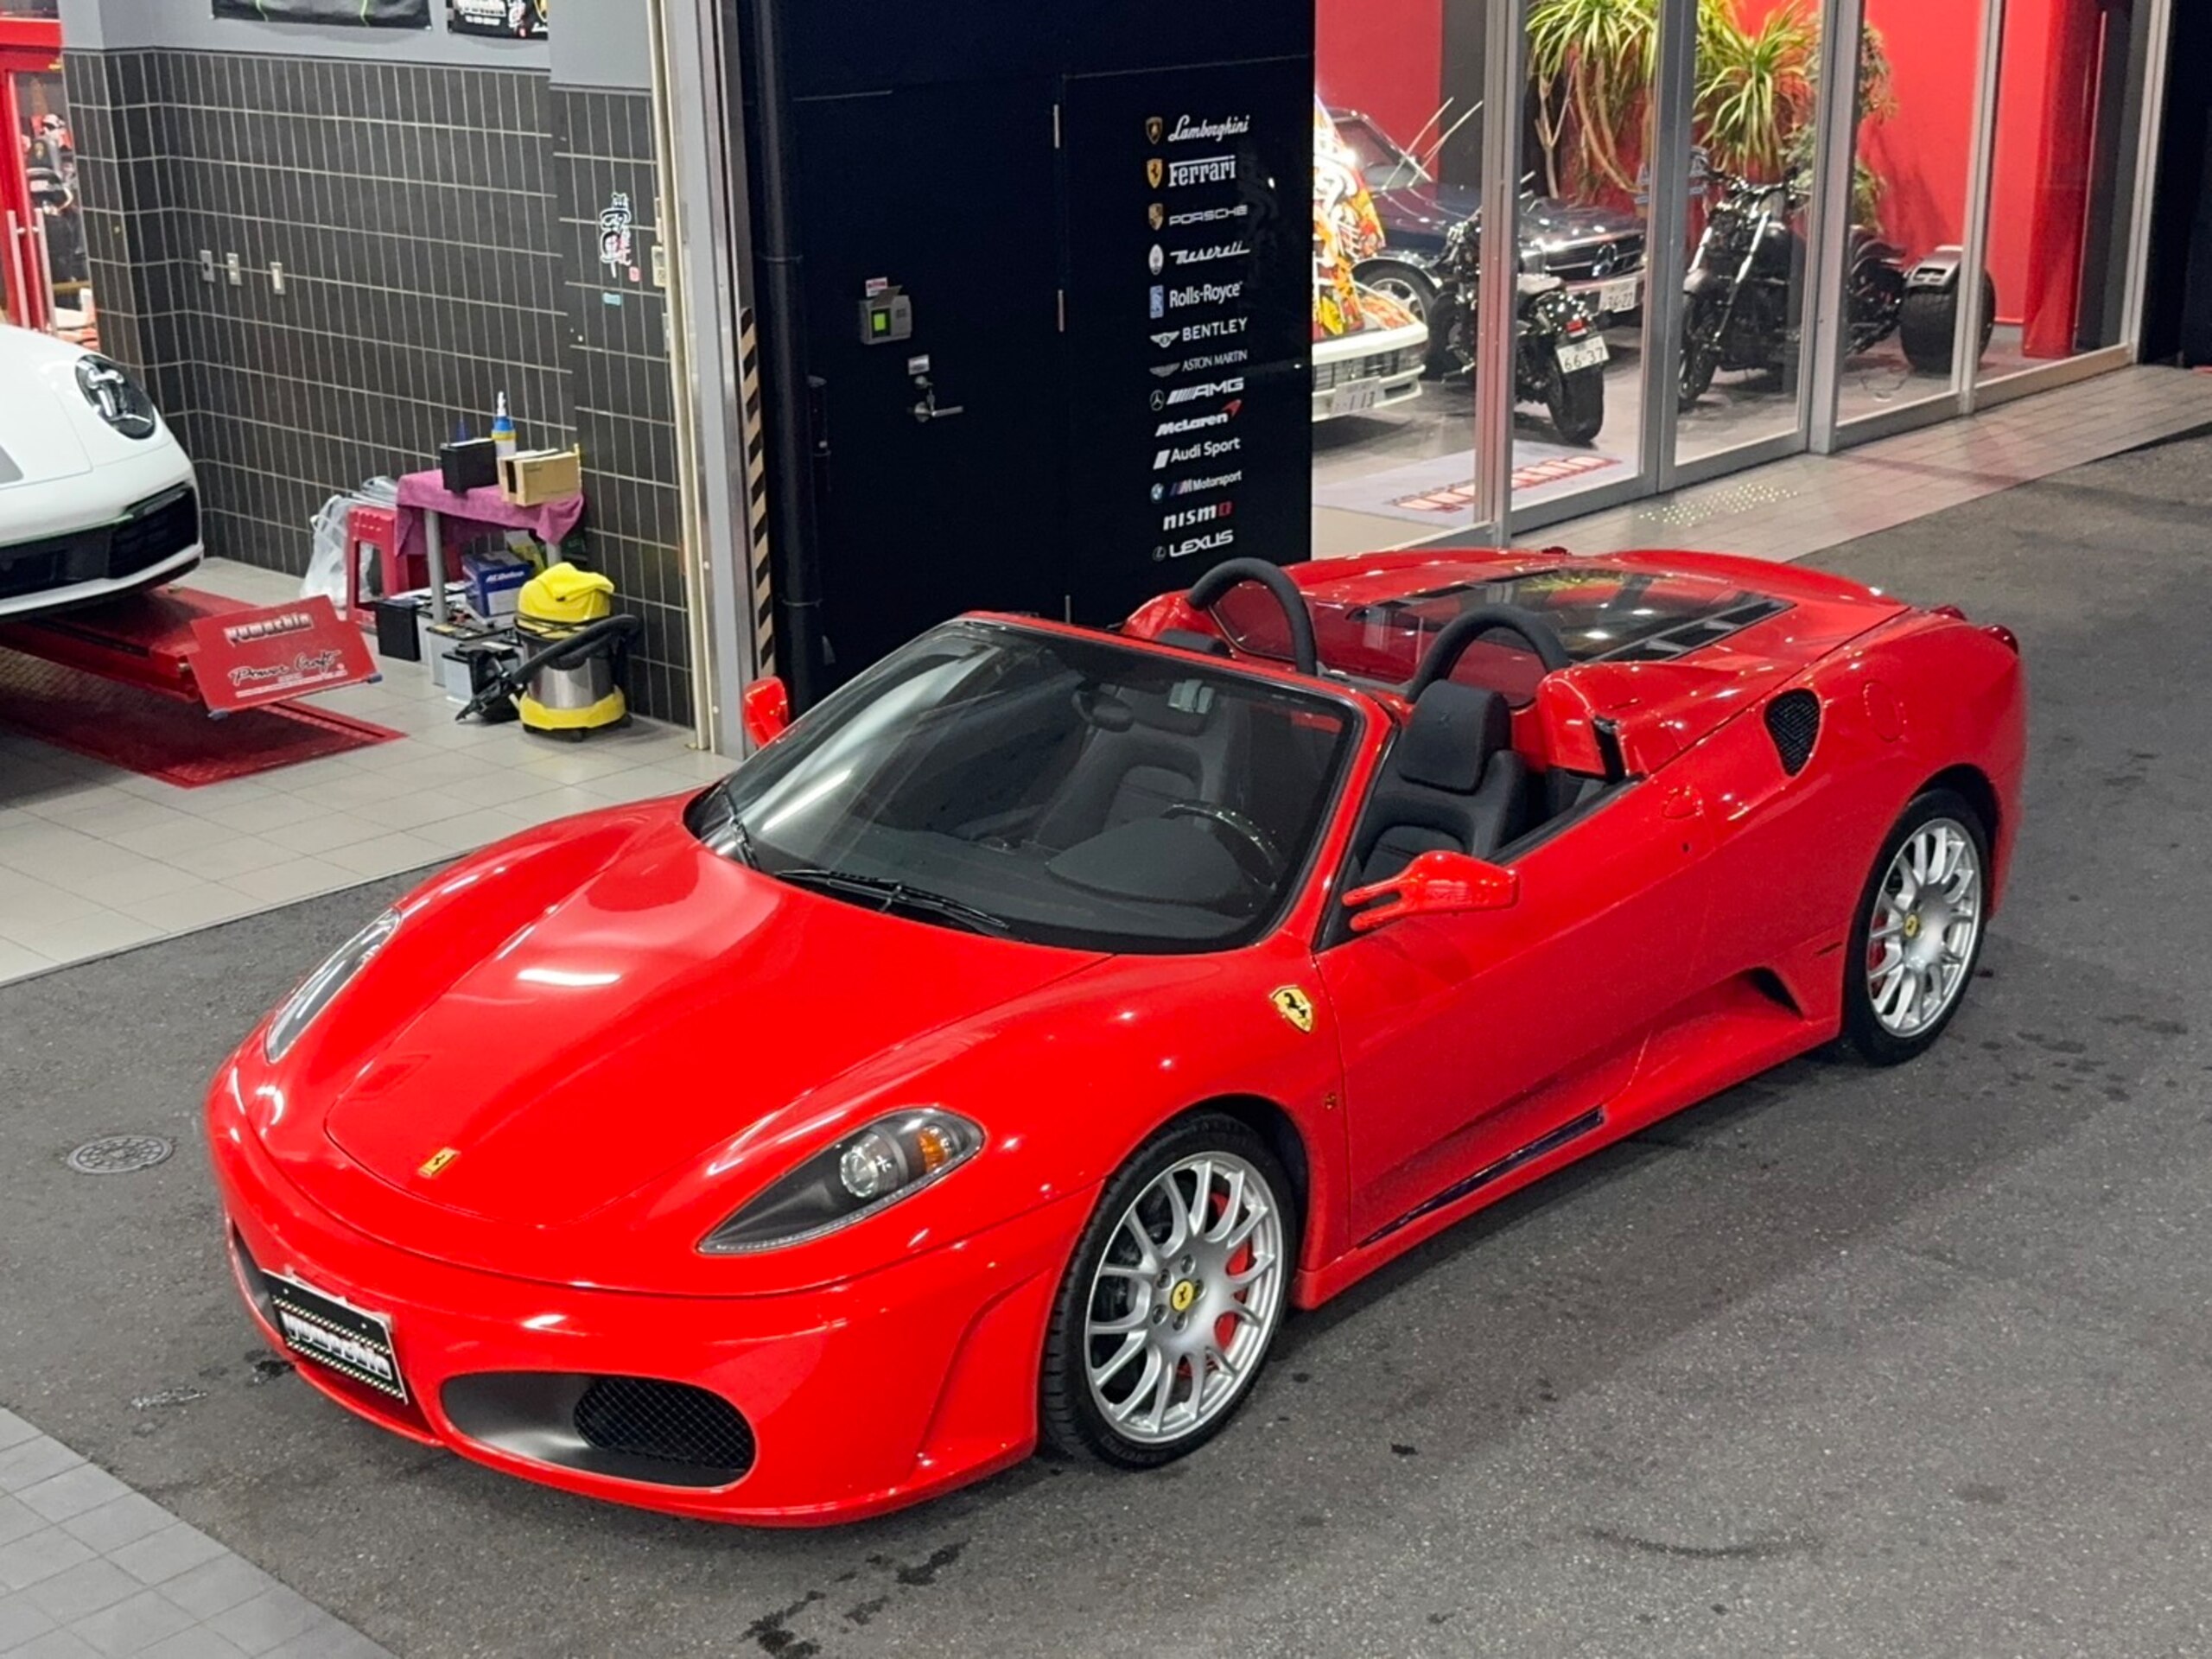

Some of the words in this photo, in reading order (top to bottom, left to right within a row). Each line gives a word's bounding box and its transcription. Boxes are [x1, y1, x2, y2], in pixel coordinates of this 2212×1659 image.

[1167, 114, 1250, 142] Lamborghini
[1168, 155, 1236, 187] Ferrari
[1169, 205, 1248, 226] PORSCHE
[1169, 281, 1242, 308] Rolls-Royce
[1182, 317, 1248, 341] BENTLEY
[1181, 356, 1212, 372] ASTON
[1214, 349, 1248, 365] MARTIN
[1191, 378, 1244, 400] AMG
[1155, 412, 1228, 437] McLaren
[1170, 443, 1202, 463] Audi
[1204, 437, 1241, 458] Sport
[1162, 501, 1233, 531] nismo
[1168, 530, 1234, 557] LEXUS
[228, 665, 289, 686] Power
